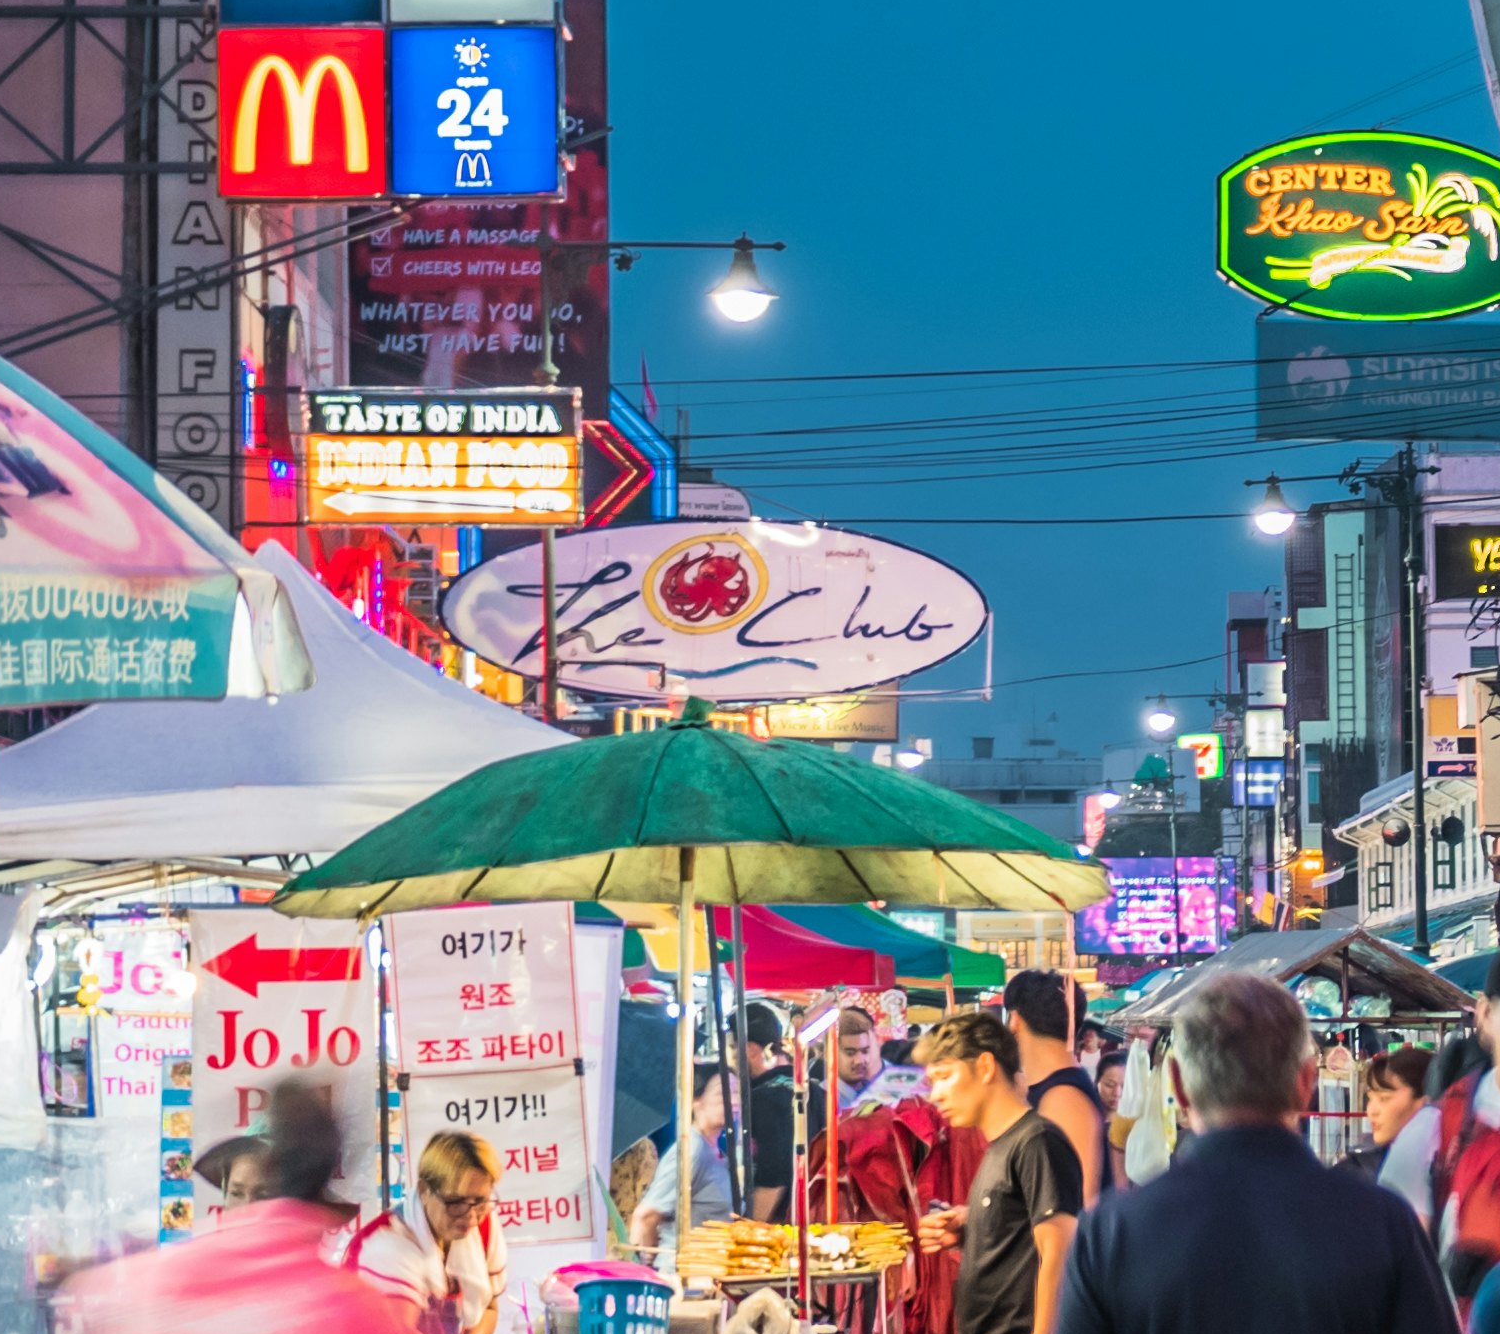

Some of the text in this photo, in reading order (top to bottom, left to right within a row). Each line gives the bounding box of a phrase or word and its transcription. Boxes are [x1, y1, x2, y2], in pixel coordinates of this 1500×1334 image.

[437, 88, 510, 138] 24
[1245, 164, 1397, 197] CENTER
[1245, 197, 1364, 238] Khao
[403, 229, 541, 246] HAVE A MASSAGE
[403, 260, 543, 277] CHEERS WITH LEO
[360, 302, 534, 323] WHATEVER YOU
[378, 333, 433, 354] JUST
[440, 333, 502, 353] HAVE
[323, 403, 564, 433] TASTE OF INDIA
[316, 440, 569, 488] INDIAN FOOD
[506, 560, 954, 664] The Club
[440, 928, 527, 962] 여기가
[456, 982, 517, 1011] 원조
[415, 1028, 567, 1066] 조조 파타이
[102, 1076, 156, 1097] Thai
[444, 1092, 549, 1126] 여기가!!
